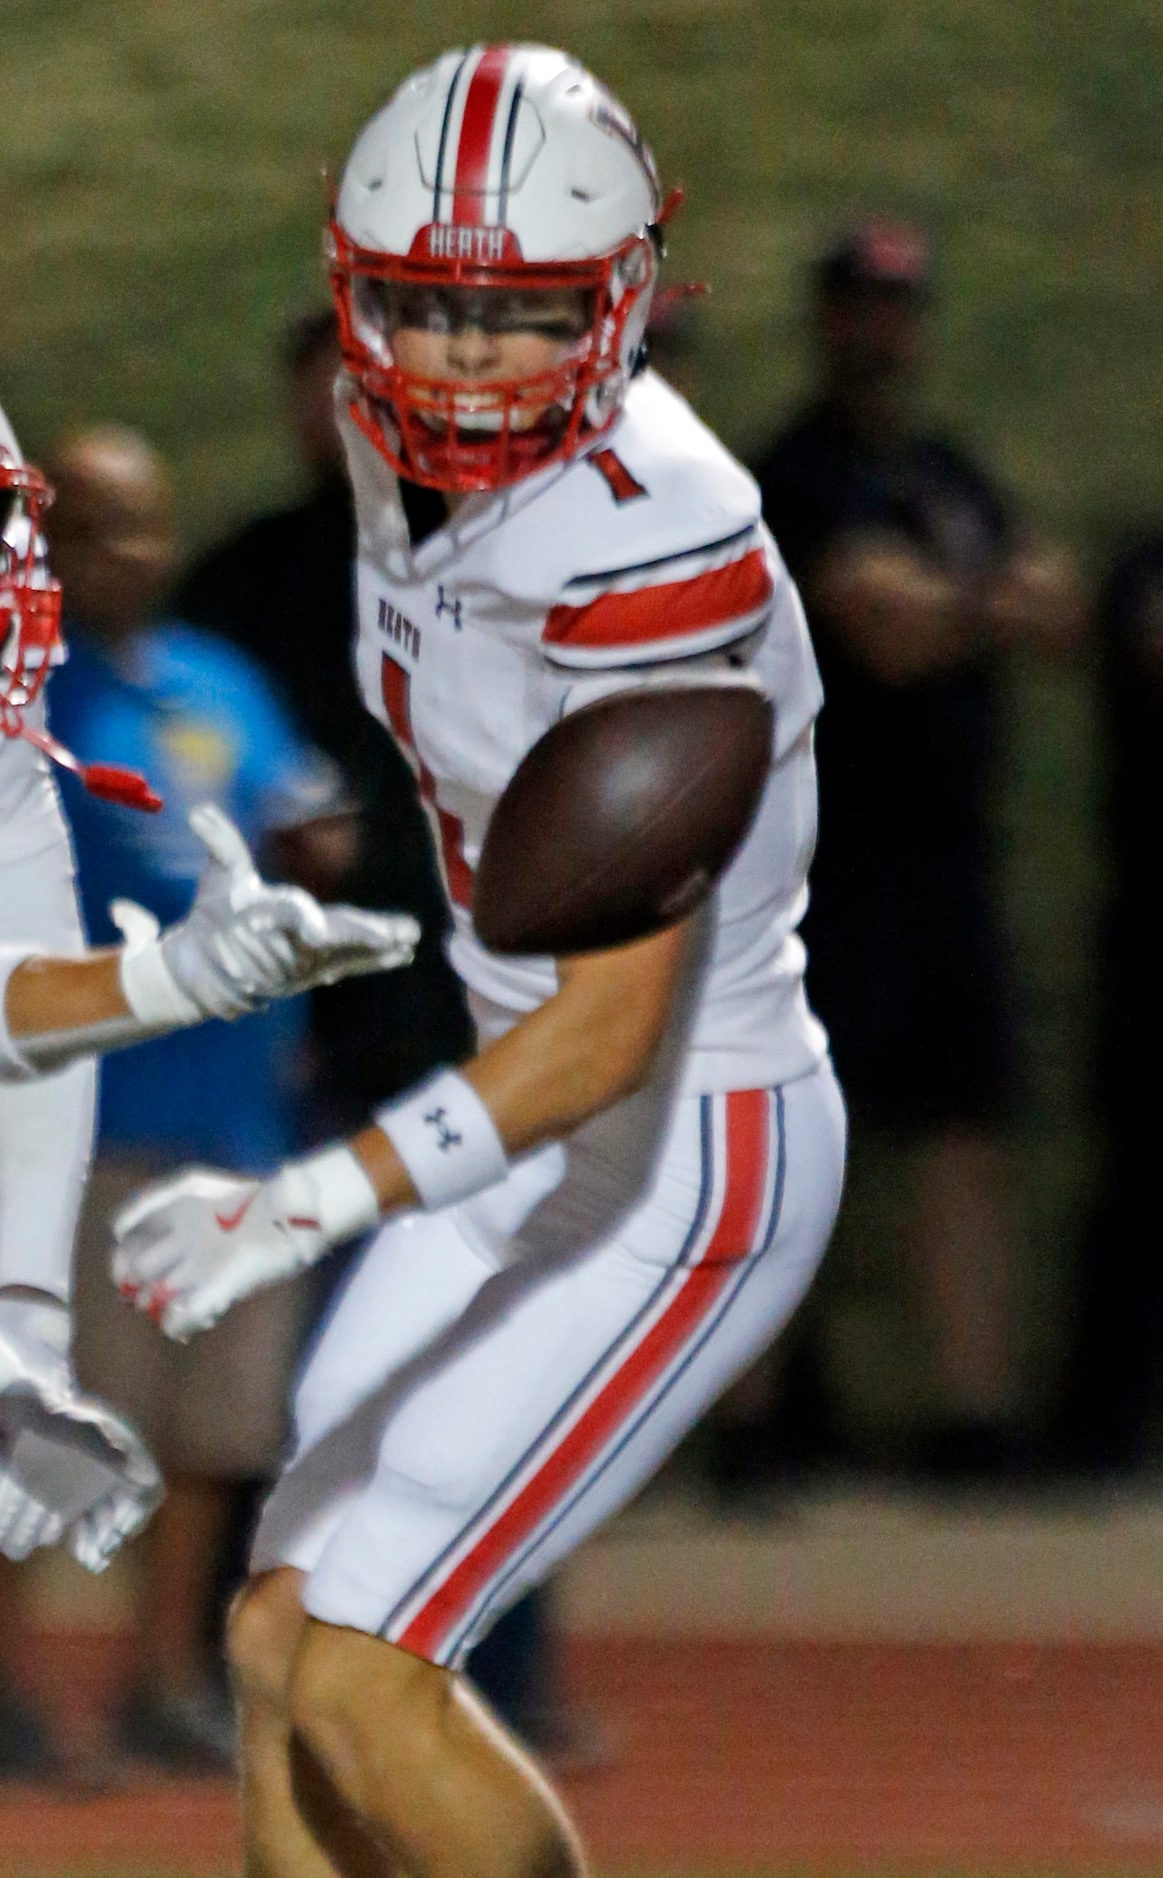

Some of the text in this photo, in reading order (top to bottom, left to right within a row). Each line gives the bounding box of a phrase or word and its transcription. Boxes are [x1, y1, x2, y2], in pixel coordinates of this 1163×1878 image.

[429, 227, 504, 260] HEATH
[585, 447, 651, 509] 1
[378, 597, 421, 663] HEATH
